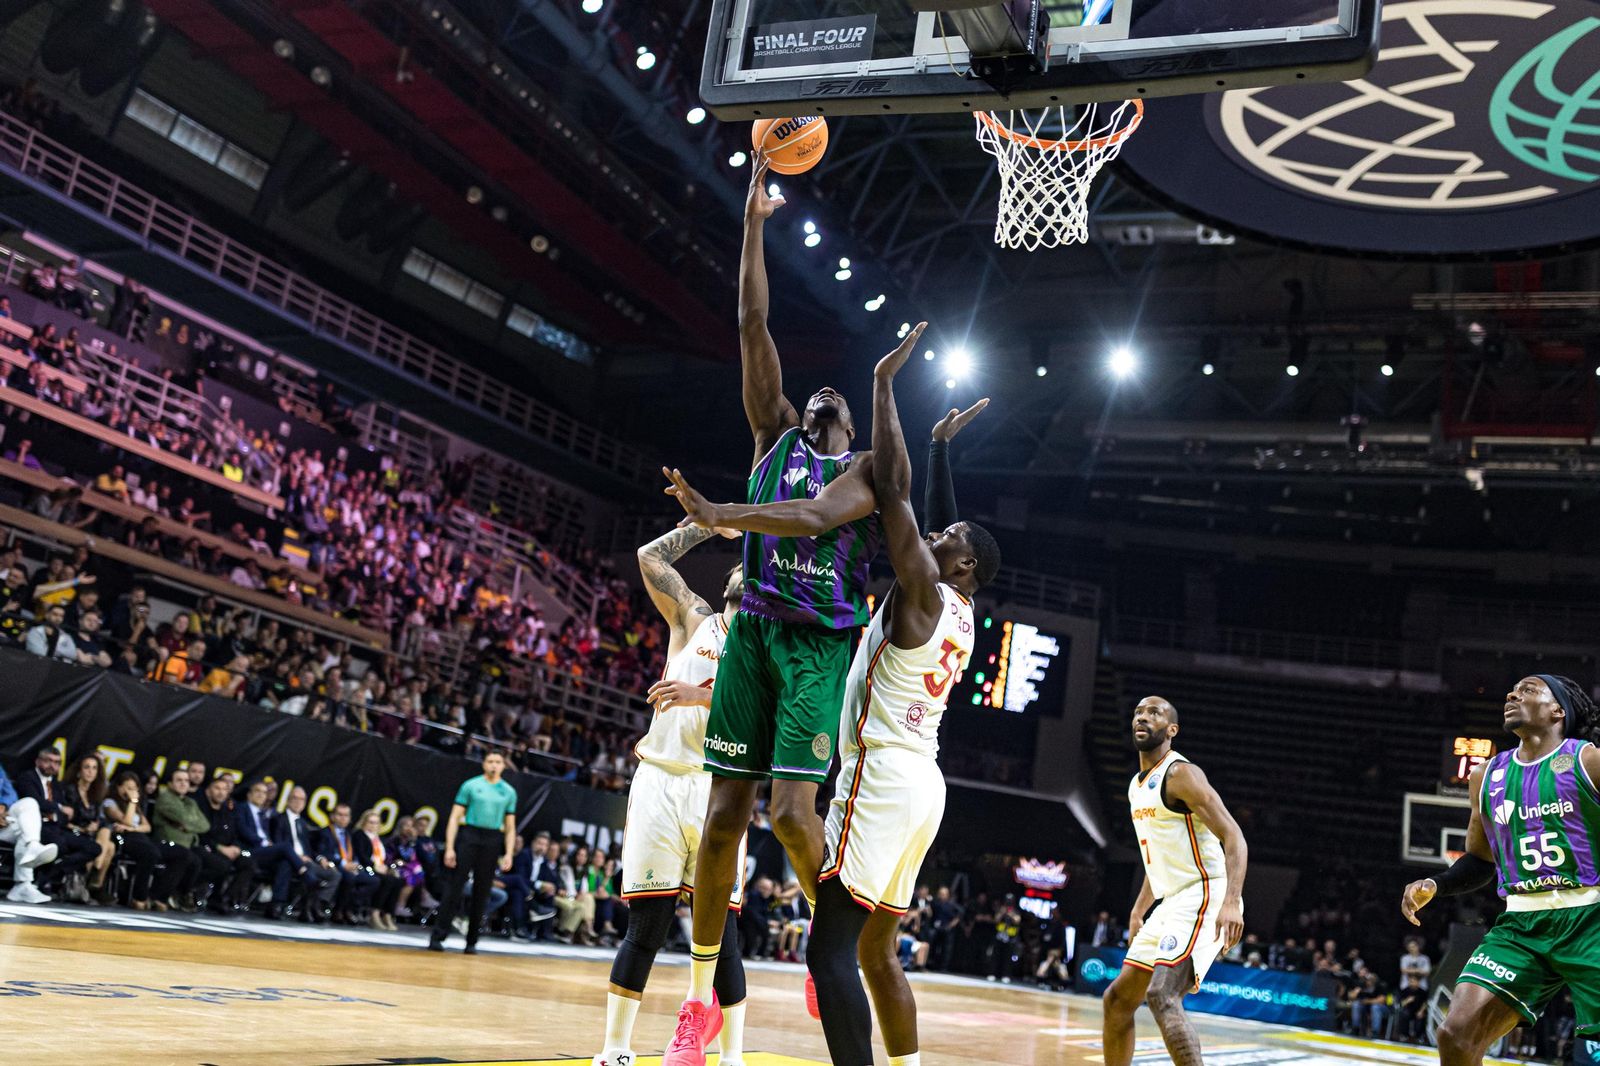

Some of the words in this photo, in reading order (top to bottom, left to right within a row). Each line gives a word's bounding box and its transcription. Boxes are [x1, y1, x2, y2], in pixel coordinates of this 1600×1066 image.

[753, 32, 809, 51] FINAL
[812, 26, 867, 46] FOUR
[753, 48, 795, 57] BASKETBALL
[795, 44, 835, 54] CHAMPIONS
[835, 42, 862, 50] LEAGUE
[769, 549, 839, 581] Andalucía
[1518, 799, 1574, 820] Unicaja
[1519, 832, 1566, 871] 55
[631, 882, 652, 890] Zeren
[651, 881, 671, 889] Metal
